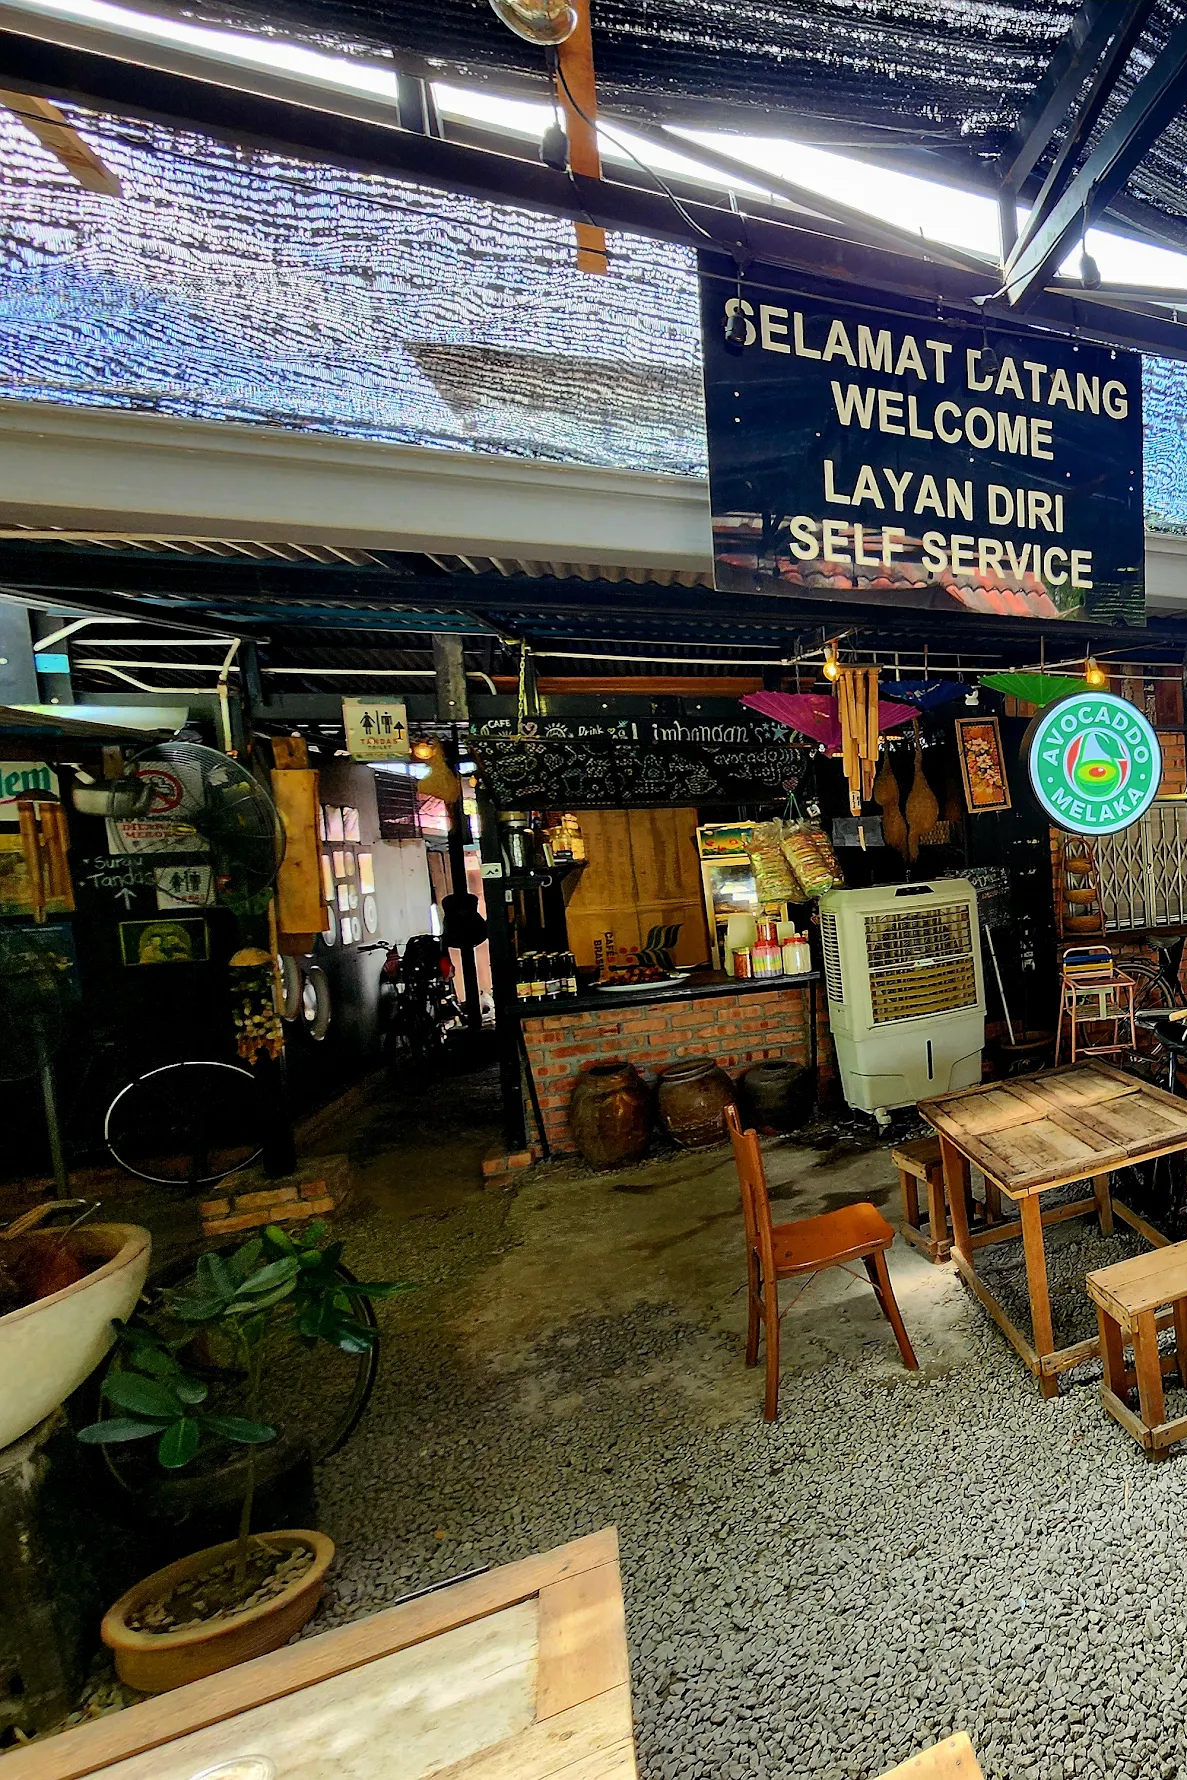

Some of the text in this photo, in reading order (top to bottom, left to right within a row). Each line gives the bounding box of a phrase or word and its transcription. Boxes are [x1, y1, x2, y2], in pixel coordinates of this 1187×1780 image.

[723, 297, 1128, 420] SELAMAT DATANG
[831, 381, 1054, 461] WELCOME
[823, 459, 1065, 534] LAYAN DIRI
[788, 515, 1094, 589] SELF SERVICE
[487, 719, 603, 737] CAFE Drink
[713, 748, 778, 765] avocado
[1043, 706, 1149, 767] AVOCADDO
[1051, 786, 1144, 822] MELAKA
